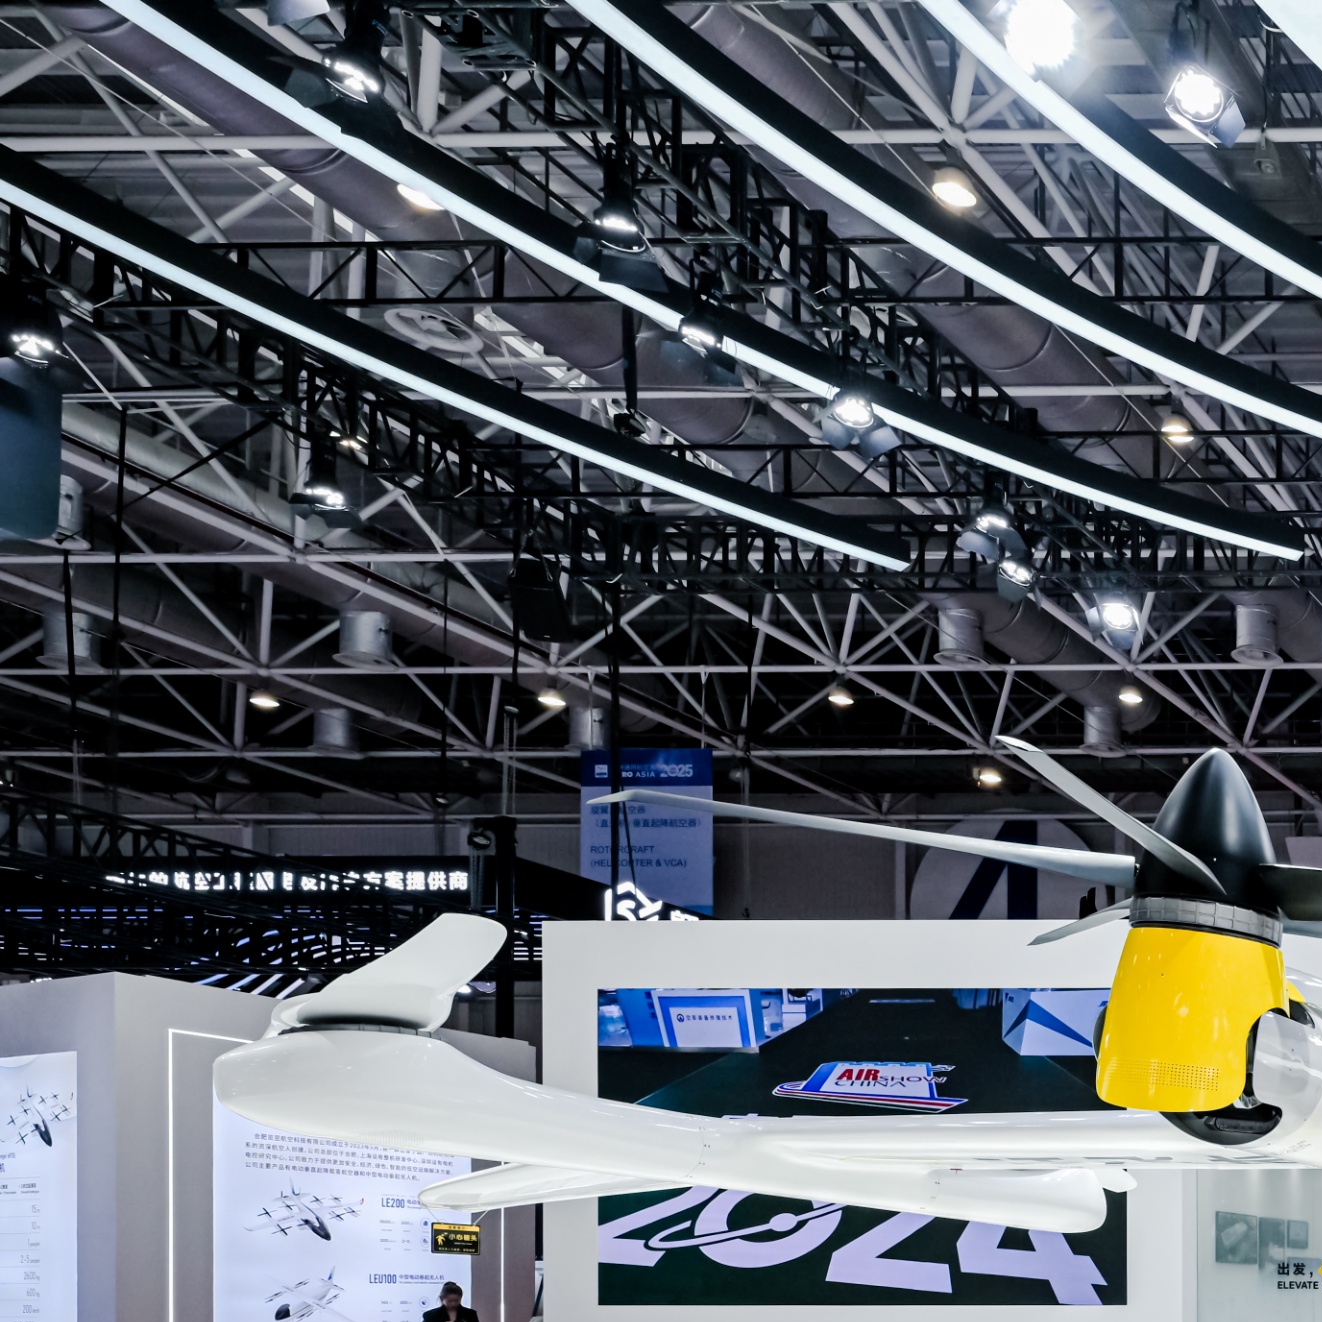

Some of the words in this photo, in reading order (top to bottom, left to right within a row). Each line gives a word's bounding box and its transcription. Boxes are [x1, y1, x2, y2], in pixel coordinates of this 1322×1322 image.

[660, 764, 694, 778] 2025
[381, 1197, 405, 1209] LE200
[369, 1273, 397, 1284] LEU100
[1277, 1280, 1319, 1290] ELEVATE
